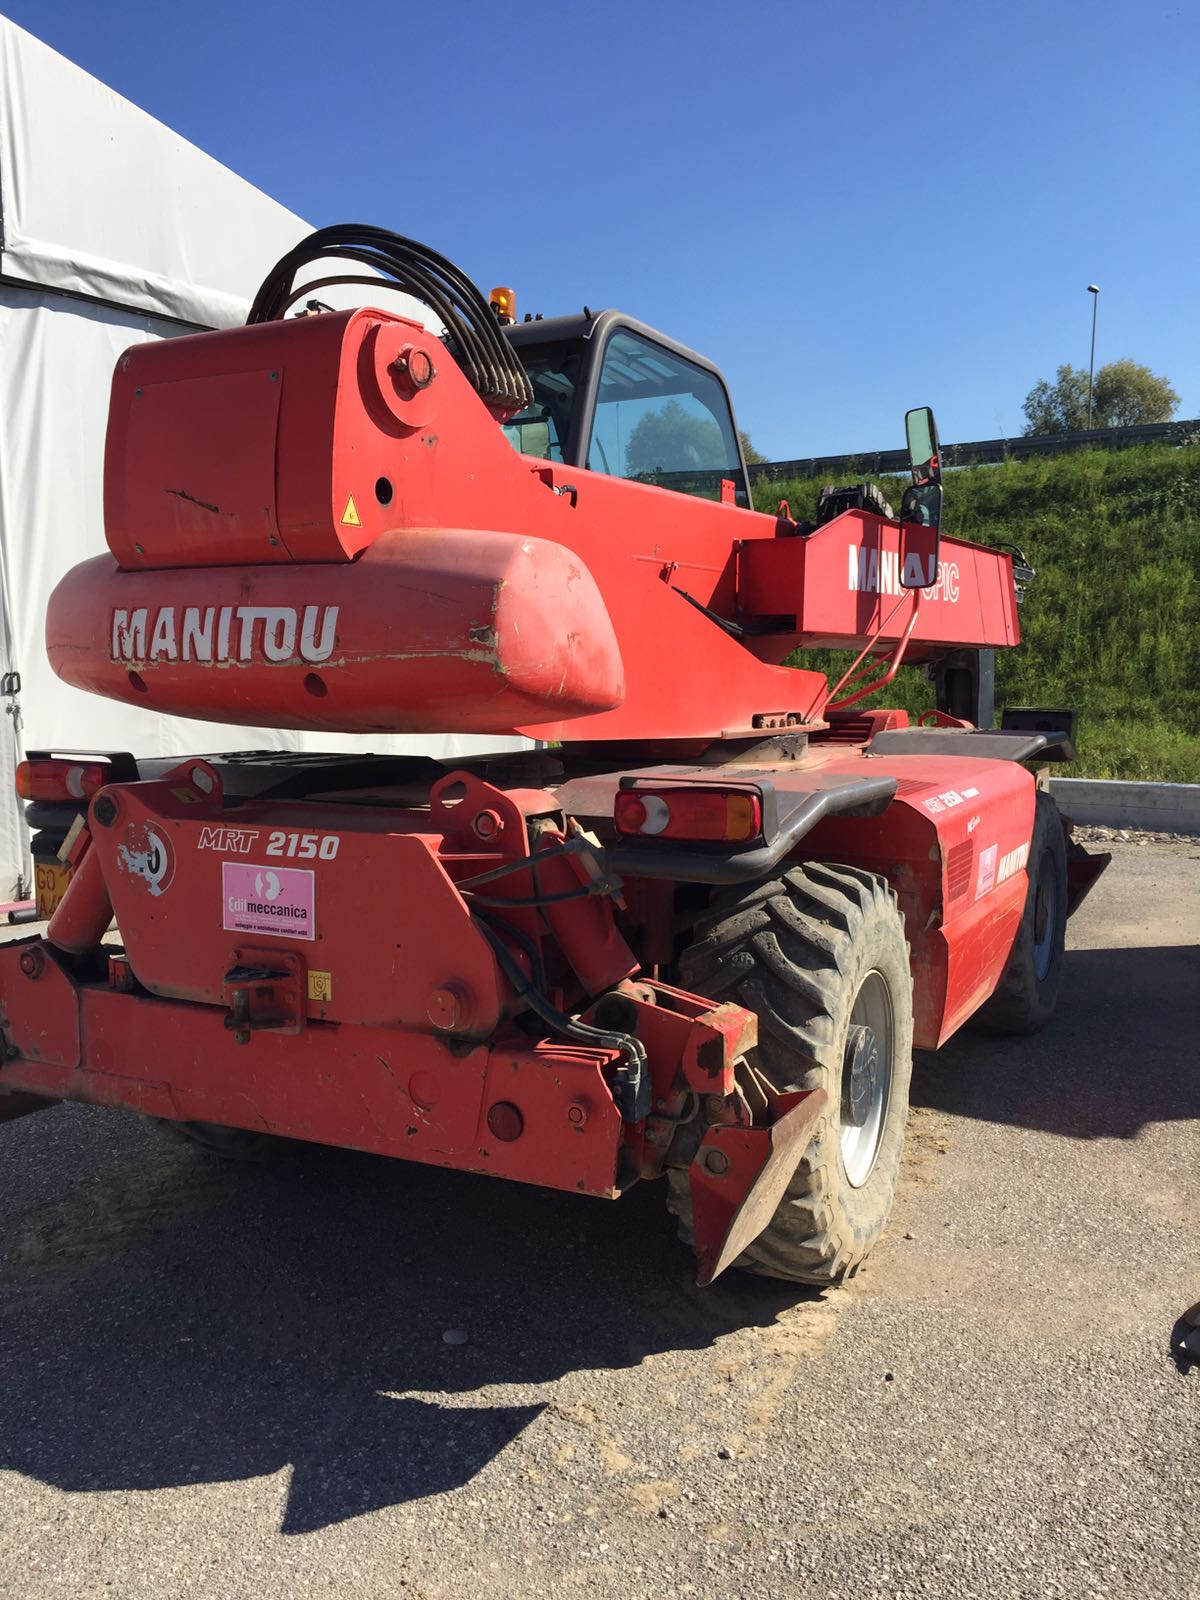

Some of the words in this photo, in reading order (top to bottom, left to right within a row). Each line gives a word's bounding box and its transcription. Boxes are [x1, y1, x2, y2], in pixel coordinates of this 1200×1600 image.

[111, 605, 340, 662] MANITOU
[197, 827, 260, 853] MRT
[265, 831, 340, 860] 2150
